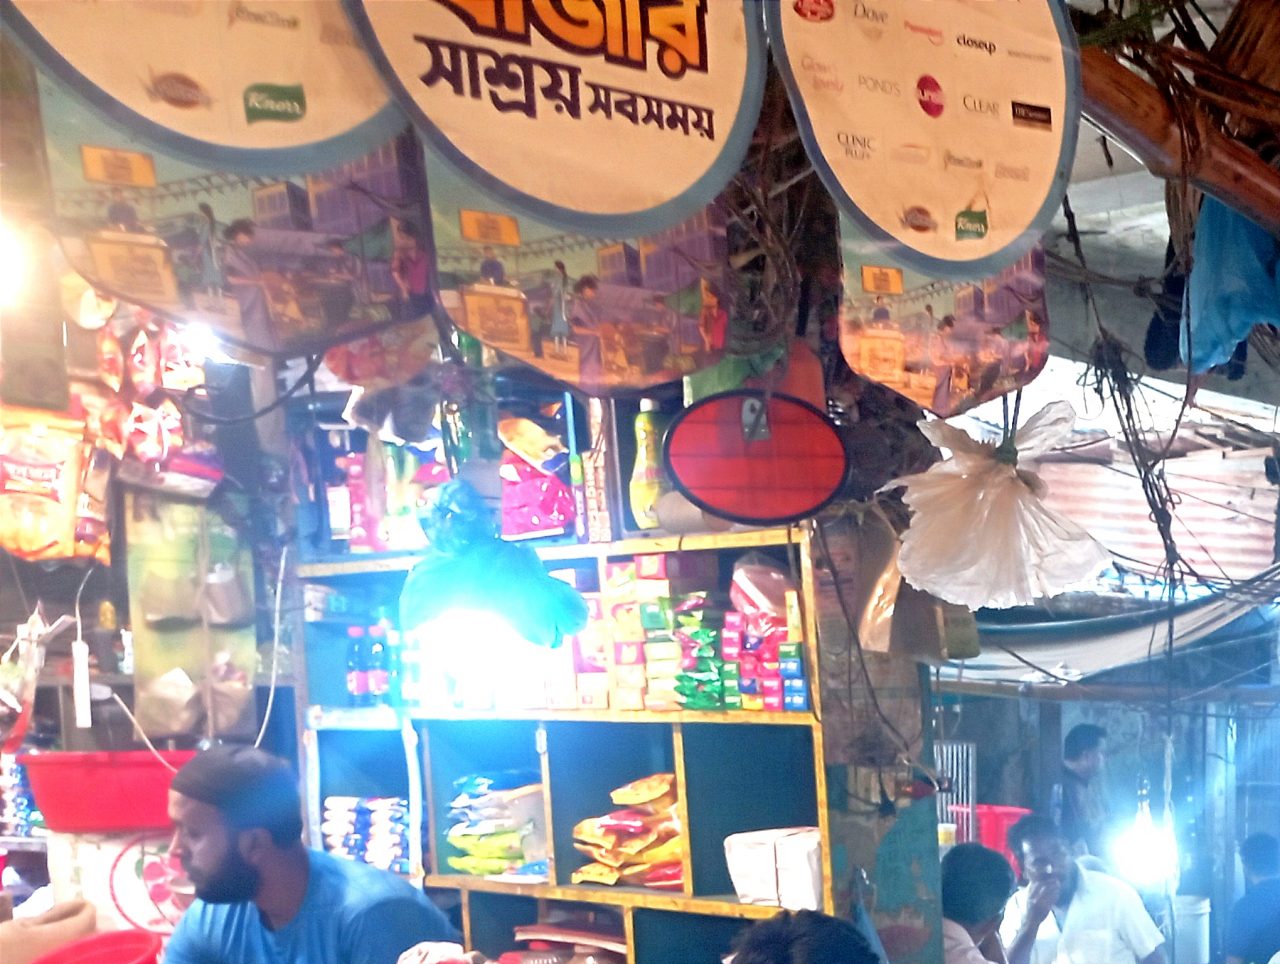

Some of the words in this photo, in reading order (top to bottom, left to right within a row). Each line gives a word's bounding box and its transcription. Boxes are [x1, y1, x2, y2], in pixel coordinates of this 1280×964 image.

[956, 34, 997, 55] closeup
[413, 35, 582, 119] সাশ্রয়
[585, 81, 715, 141] সবসময়
